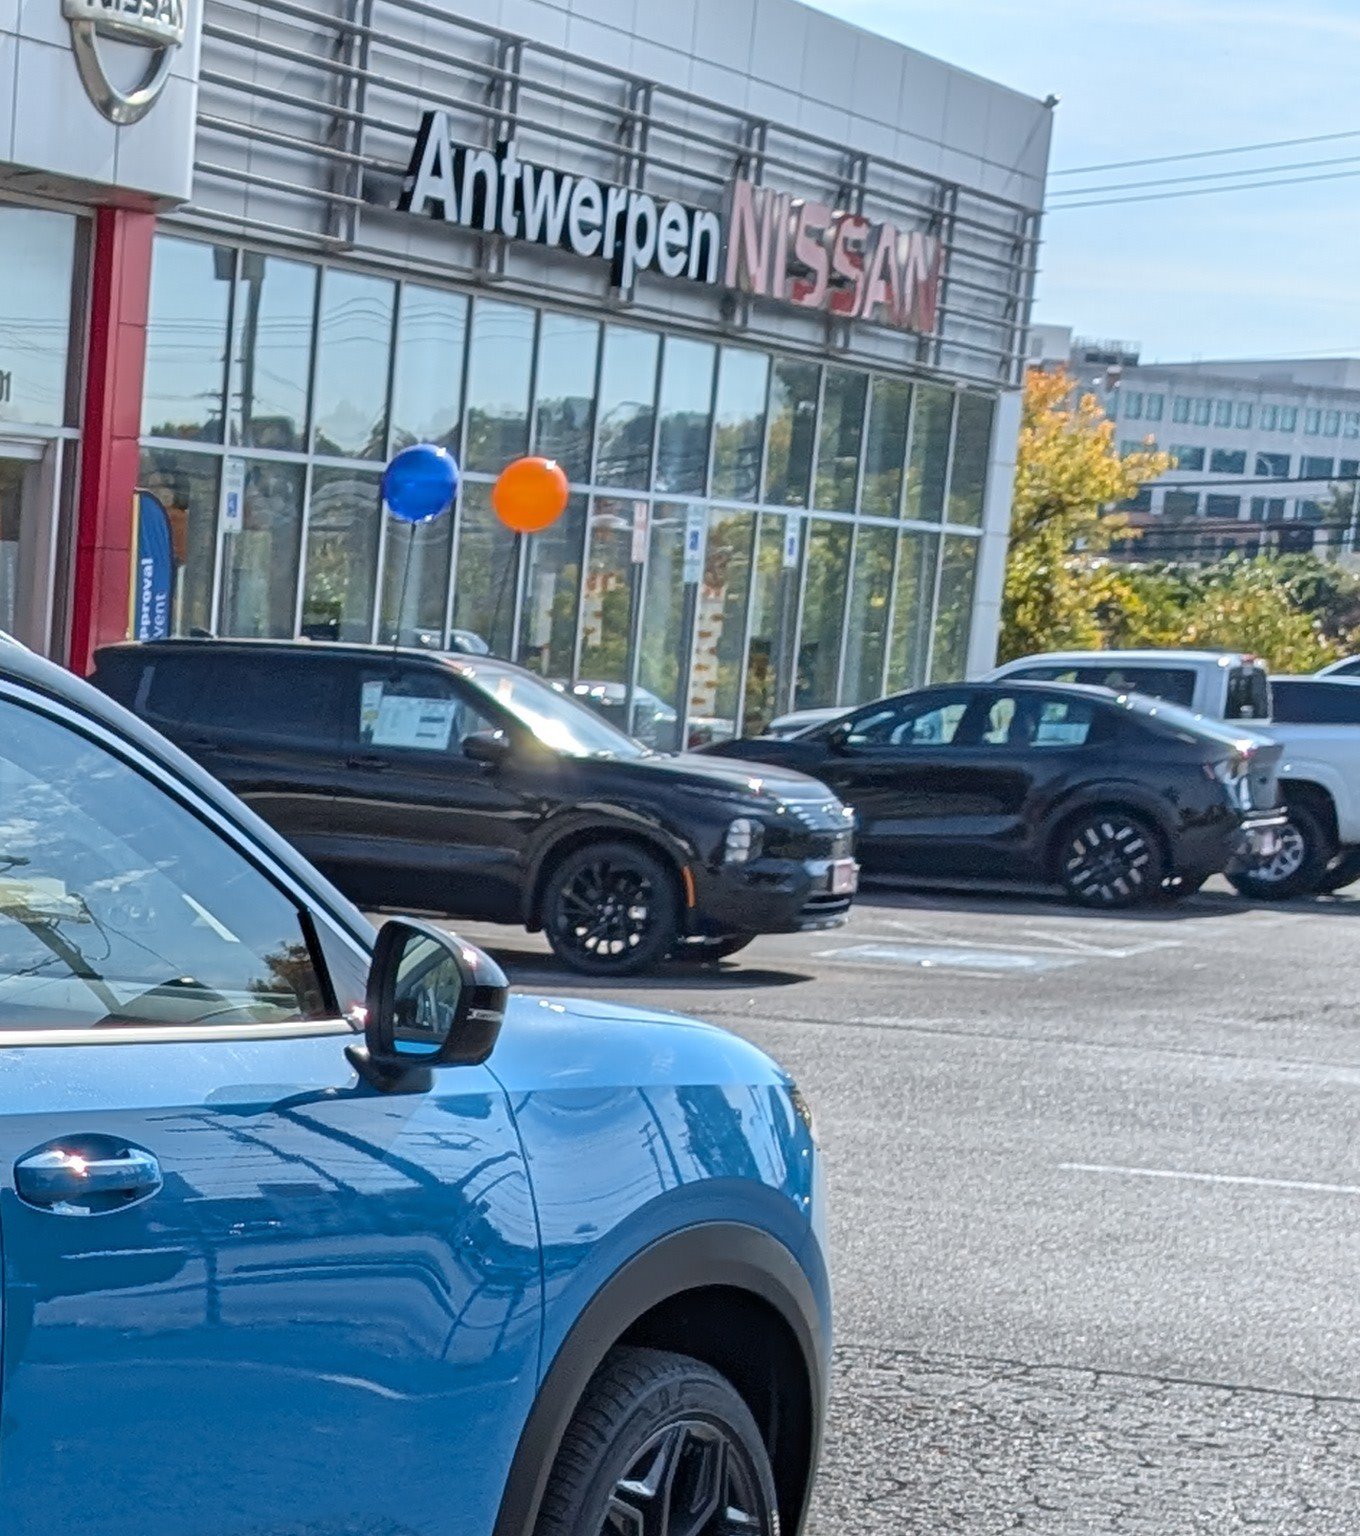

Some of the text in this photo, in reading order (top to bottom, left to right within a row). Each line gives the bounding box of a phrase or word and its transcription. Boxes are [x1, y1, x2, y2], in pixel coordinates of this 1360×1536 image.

[408, 110, 943, 335] Antwerpen NISSAN
[139, 558, 153, 640] pproval
[153, 592, 166, 638] vent
